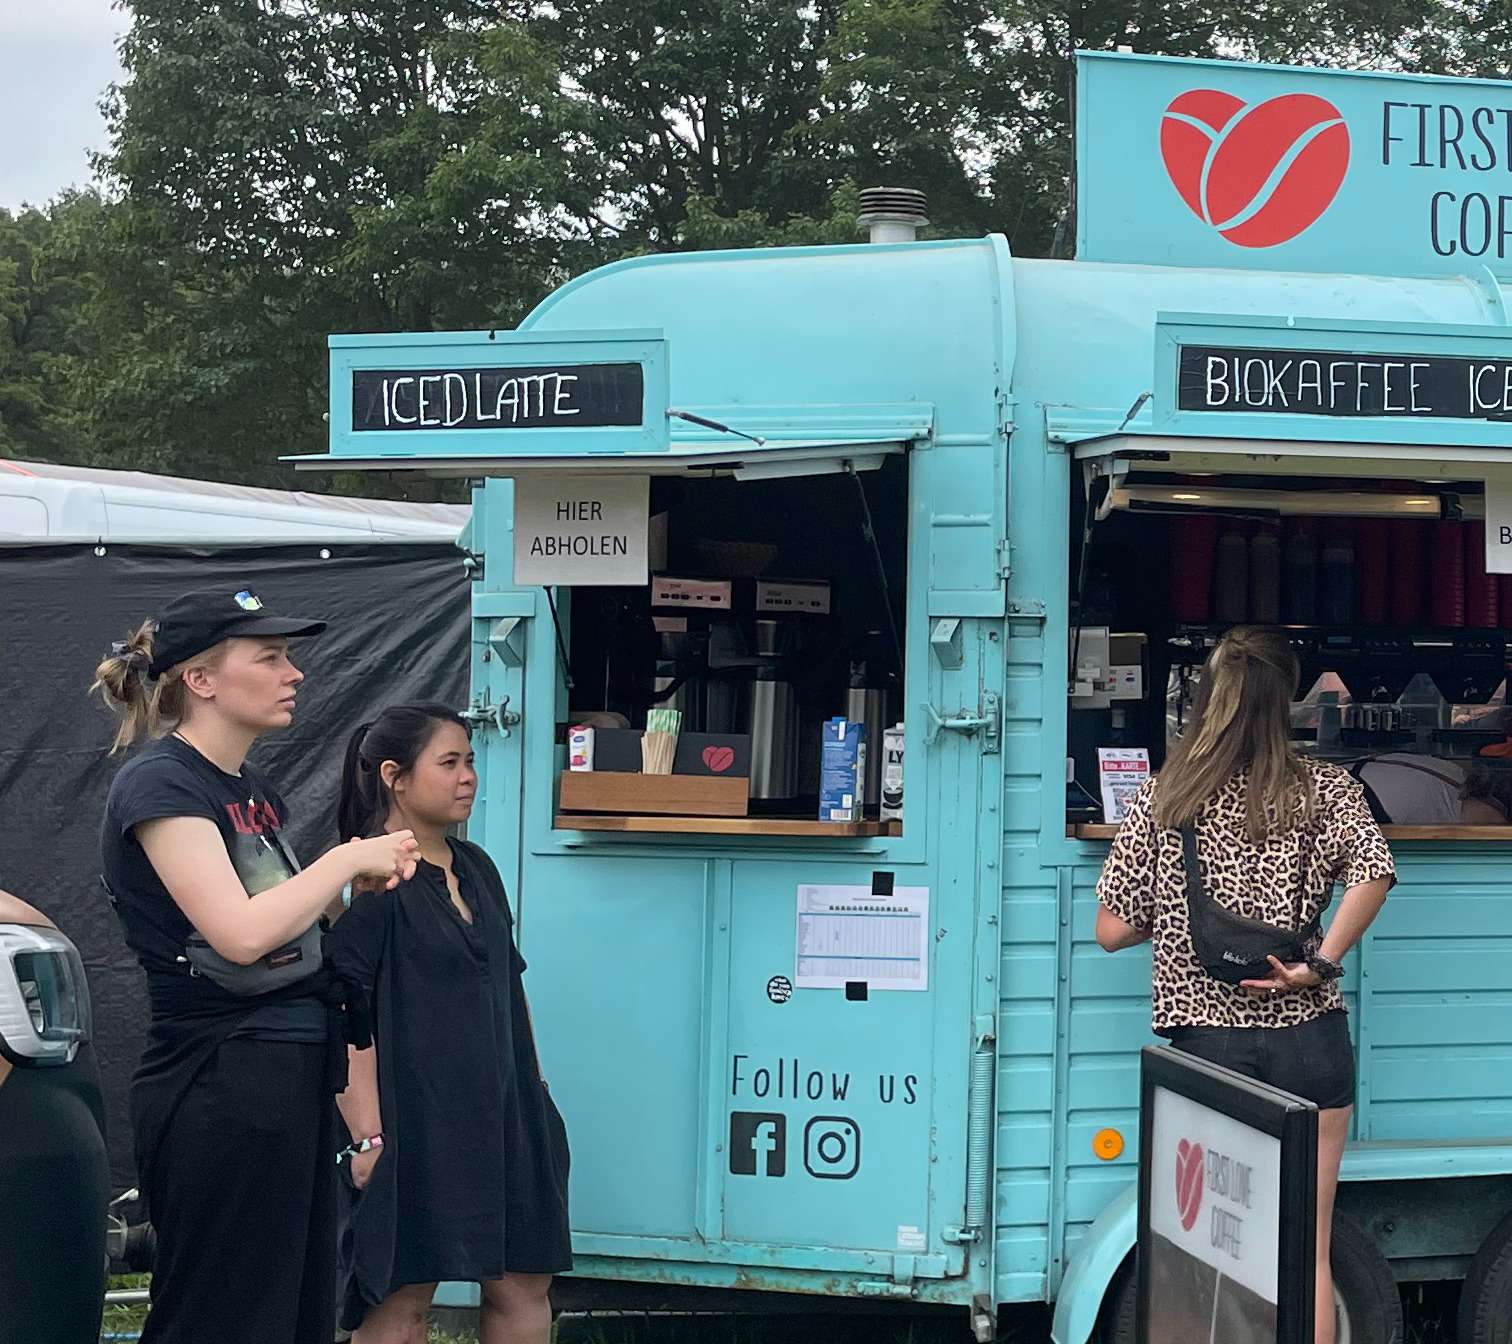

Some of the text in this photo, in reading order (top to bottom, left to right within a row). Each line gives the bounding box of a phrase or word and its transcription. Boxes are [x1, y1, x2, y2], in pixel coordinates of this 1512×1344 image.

[555, 501, 603, 522] HIER
[530, 535, 628, 557] ABHOLEN
[732, 1054, 850, 1101] Follow
